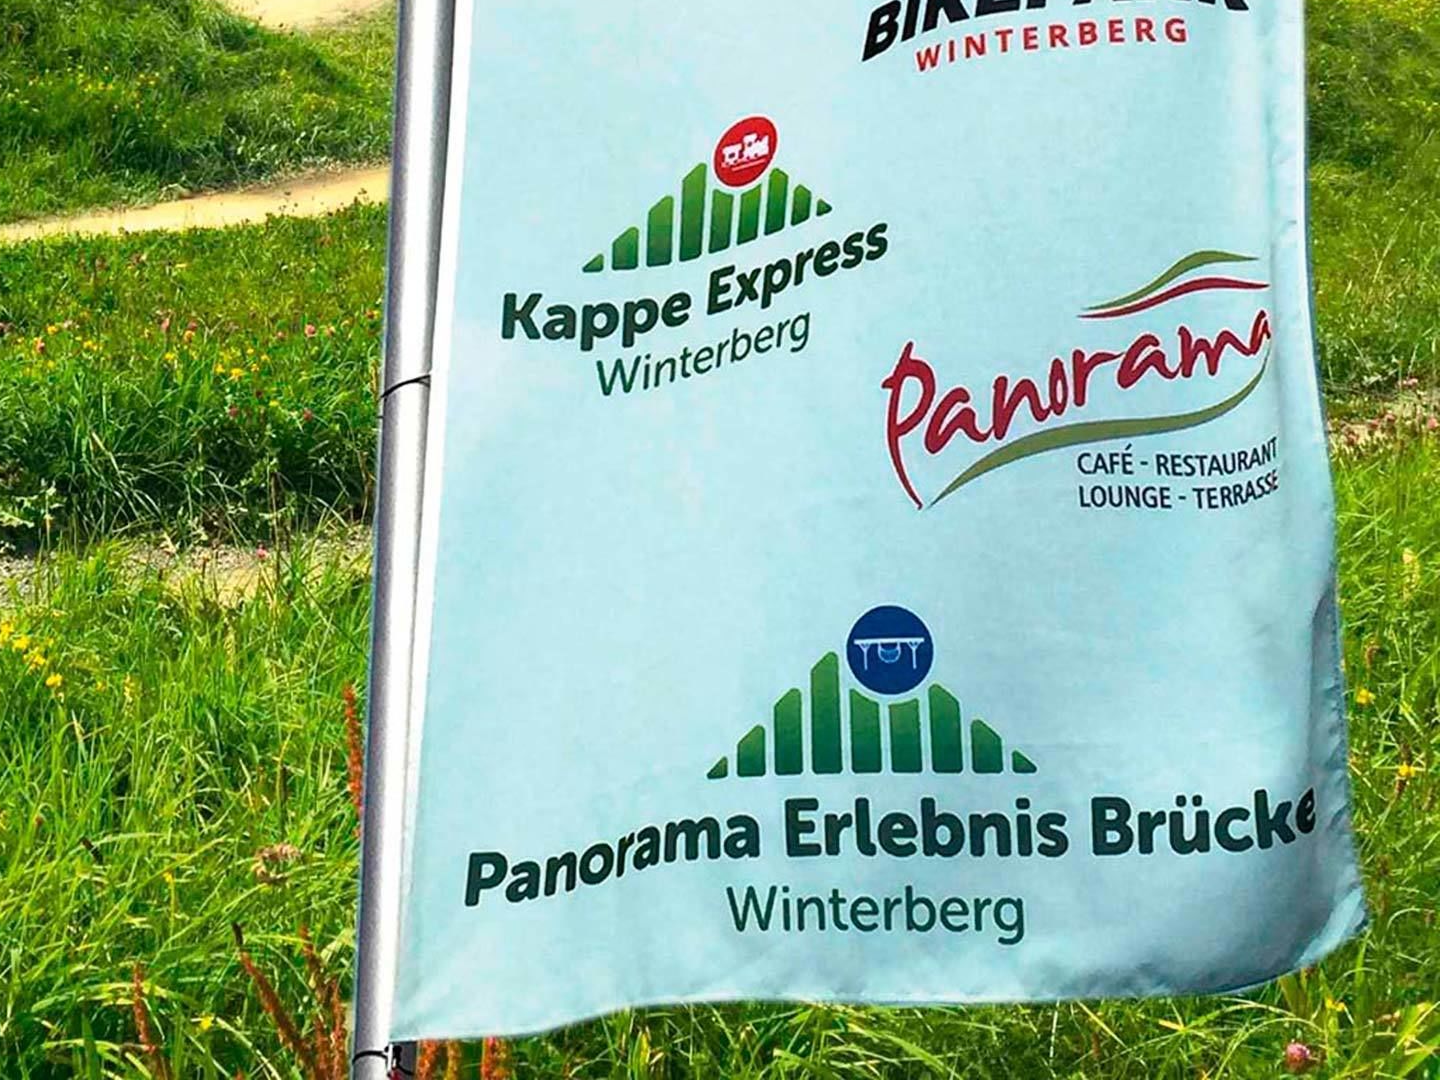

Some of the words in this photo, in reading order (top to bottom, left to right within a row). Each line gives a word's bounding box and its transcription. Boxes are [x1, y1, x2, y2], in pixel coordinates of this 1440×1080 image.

[915, 17, 1188, 72] WINTERBERG
[501, 291, 691, 351] Kappe
[707, 223, 888, 315] Express
[596, 311, 810, 396] Winterberg
[881, 310, 1271, 510] Panorama
[1077, 444, 1133, 475] CAFÉ
[1155, 436, 1278, 477] RESTAURANT
[1078, 485, 1171, 509] LOUNGE
[1192, 469, 1279, 510] TERRASSE
[464, 810, 759, 908] Panorama
[785, 796, 1069, 860] Erlebnis
[1091, 788, 1315, 856] Brücke
[726, 885, 1026, 945] Winterberg
